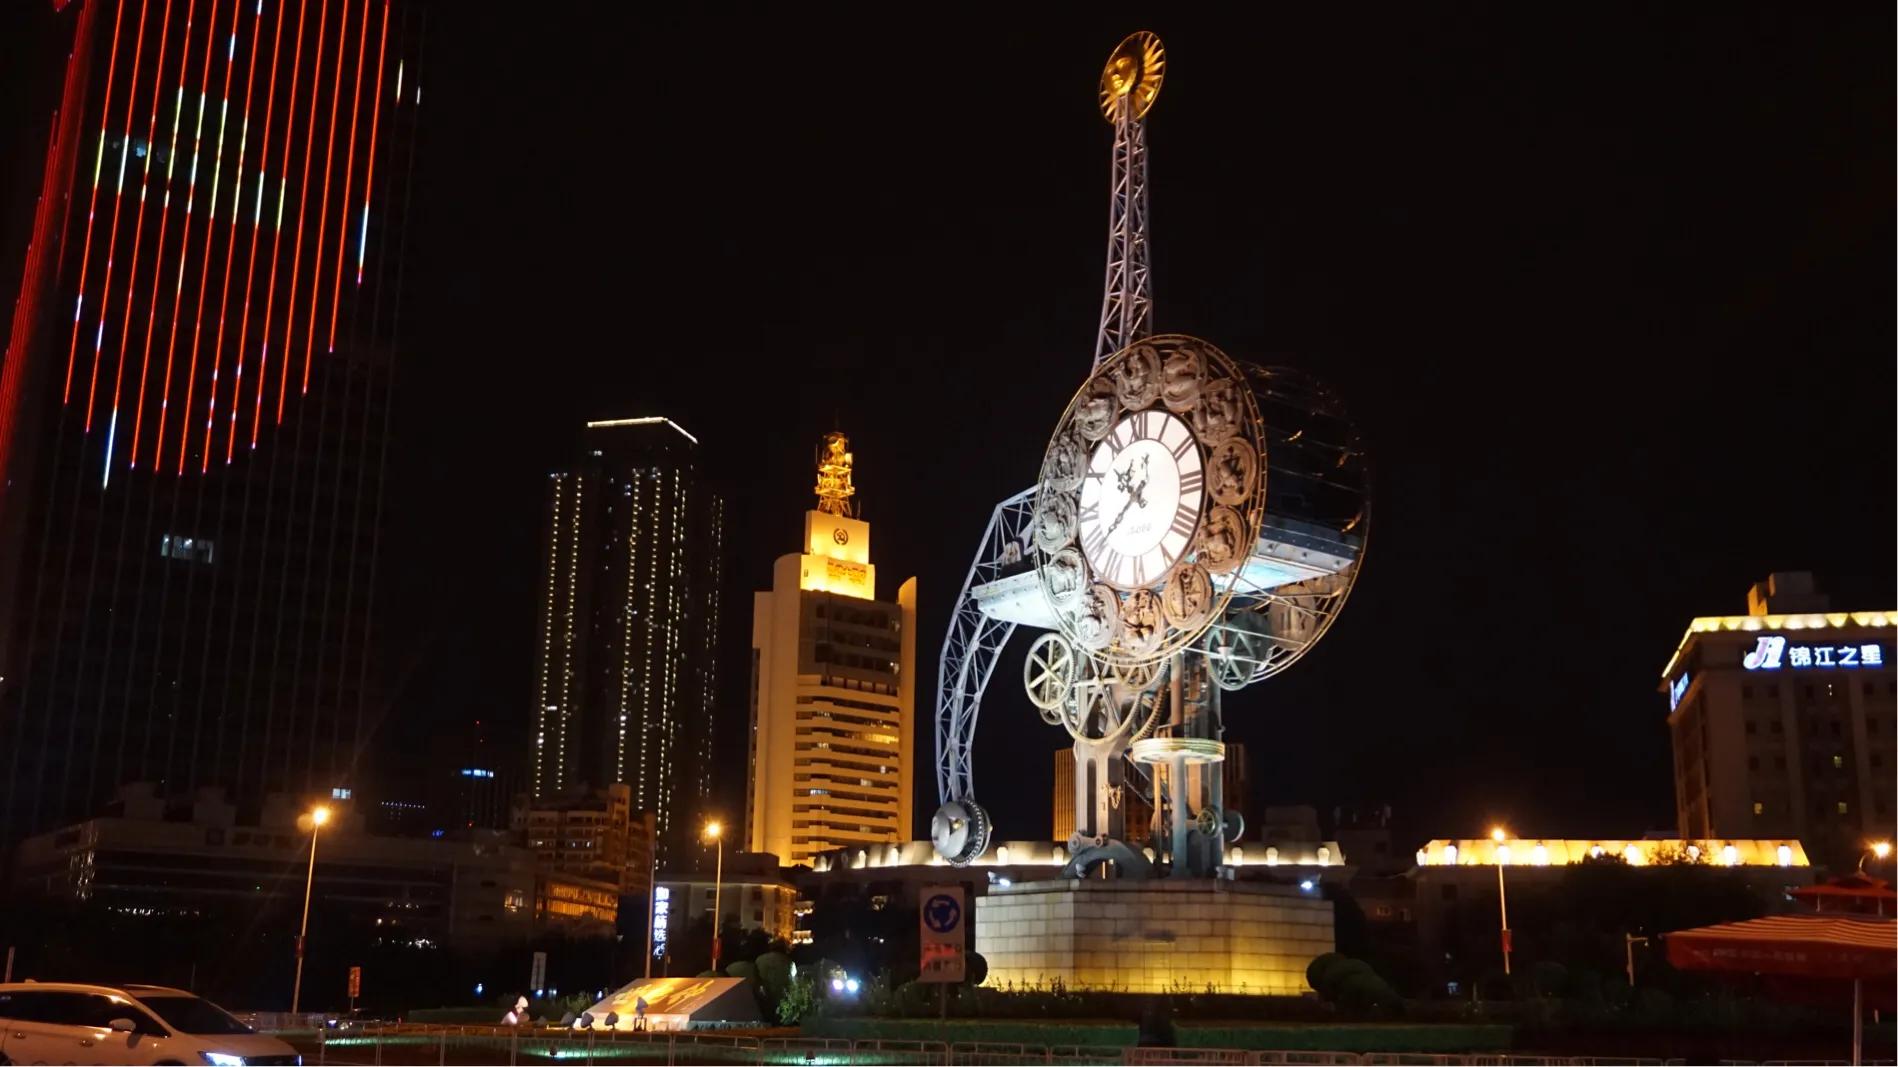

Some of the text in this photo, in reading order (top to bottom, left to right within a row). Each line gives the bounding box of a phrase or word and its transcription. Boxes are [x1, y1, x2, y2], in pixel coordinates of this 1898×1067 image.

[1180, 469, 1202, 496] III
[1789, 645, 1882, 667] 锦江之星
